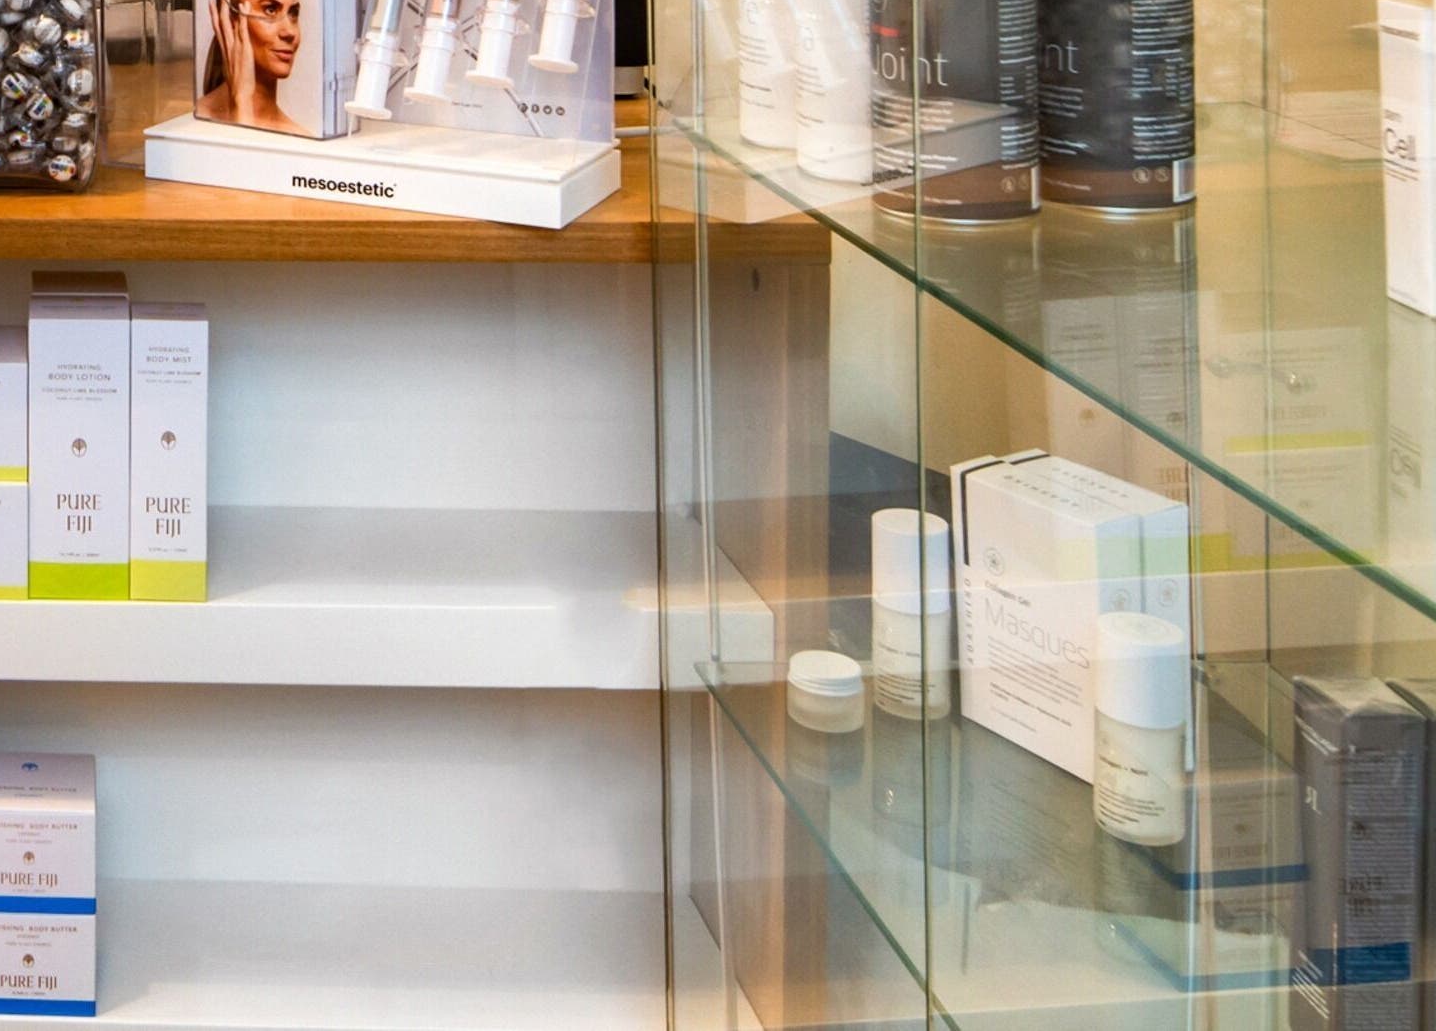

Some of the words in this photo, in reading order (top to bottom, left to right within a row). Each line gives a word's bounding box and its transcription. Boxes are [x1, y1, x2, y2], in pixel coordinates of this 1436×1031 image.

[291, 173, 395, 199] mesoestetic
[146, 355, 170, 363] BODY
[172, 356, 192, 364] MIST
[48, 373, 73, 381] BODY
[76, 373, 111, 382] LOTION
[57, 493, 102, 510] PURE
[145, 497, 191, 514] PURE
[66, 515, 92, 534] FIJI
[155, 519, 181, 538] FIJI
[984, 597, 1090, 670] Masques
[29, 822, 49, 830] BODY
[51, 823, 78, 831] BUTTER
[0, 872, 35, 886] PURE
[38, 873, 58, 888] FIJI
[0, 975, 34, 989] PURE
[38, 975, 58, 991] FIJI
